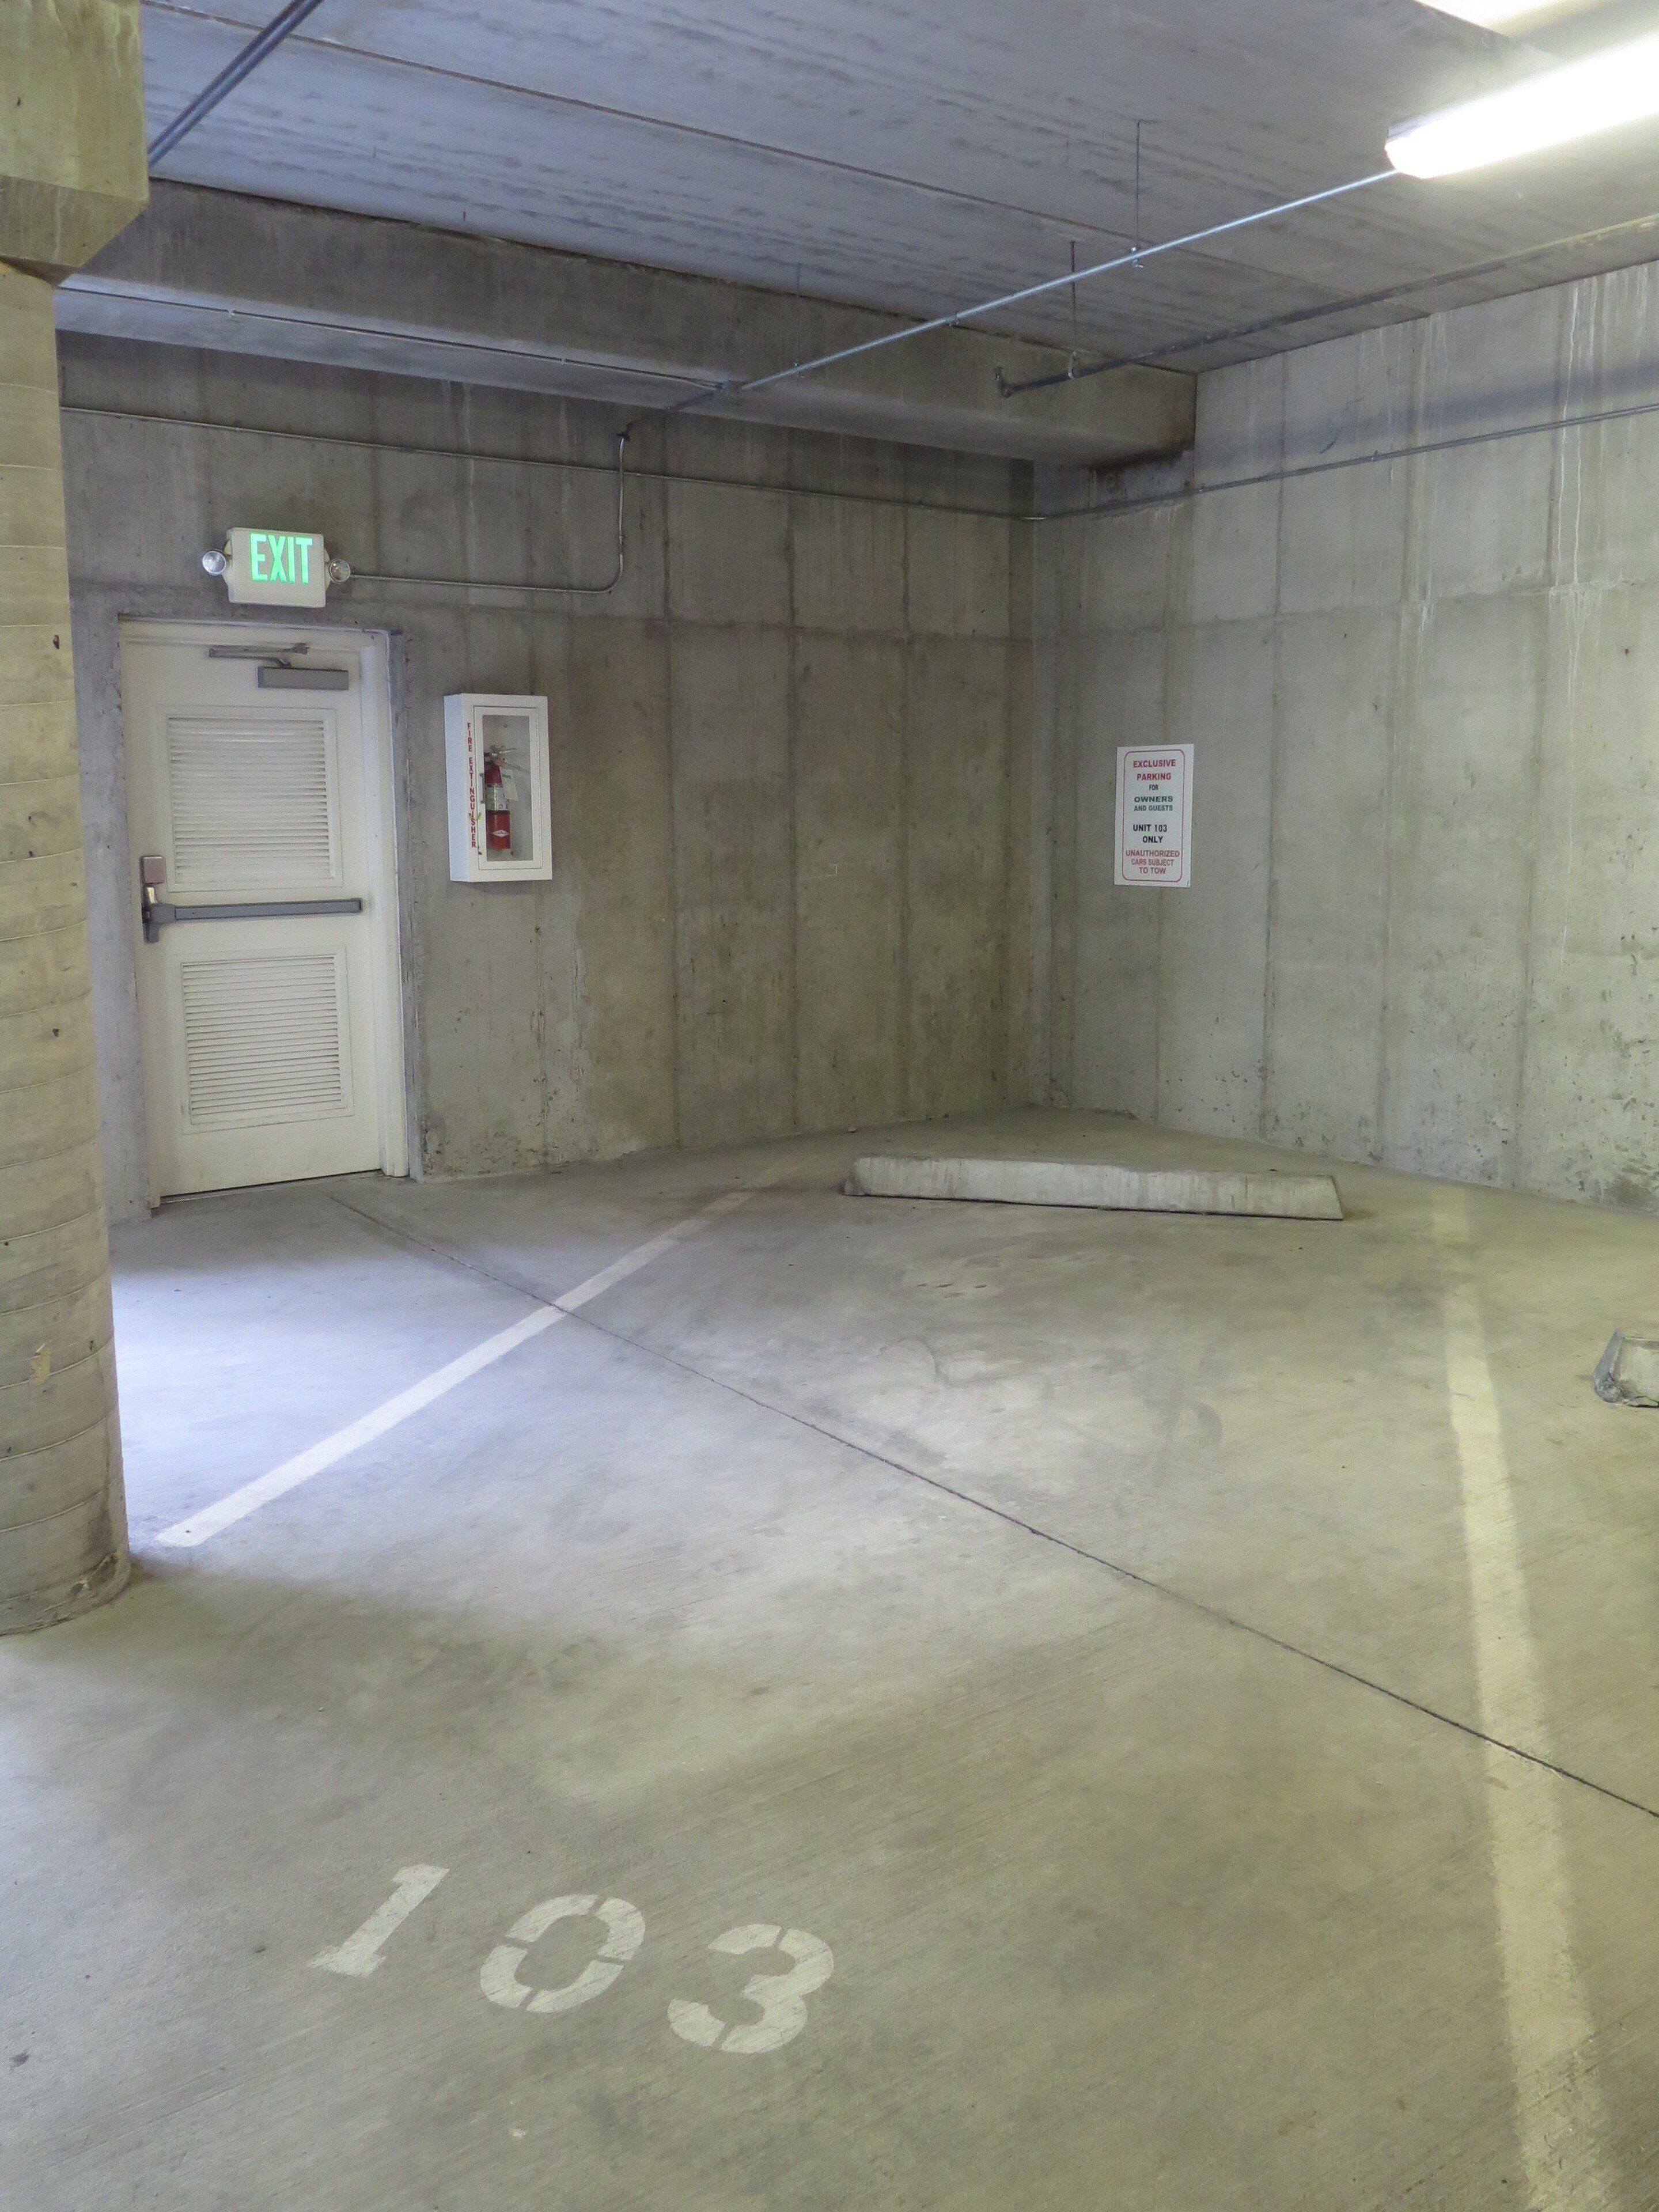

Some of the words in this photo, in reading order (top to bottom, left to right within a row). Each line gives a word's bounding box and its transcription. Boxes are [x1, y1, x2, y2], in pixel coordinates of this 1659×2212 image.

[250, 533, 313, 584] EXIT
[1133, 759, 1176, 768] EXCLUSIVE
[1137, 772, 1172, 781] PARKING
[1132, 824, 1152, 832] UNIT
[1154, 824, 1168, 832] 103
[1142, 835, 1164, 843] ONLY
[1126, 850, 1180, 858] UNAUTHORIZED
[307, 1863, 834, 2054] 103
